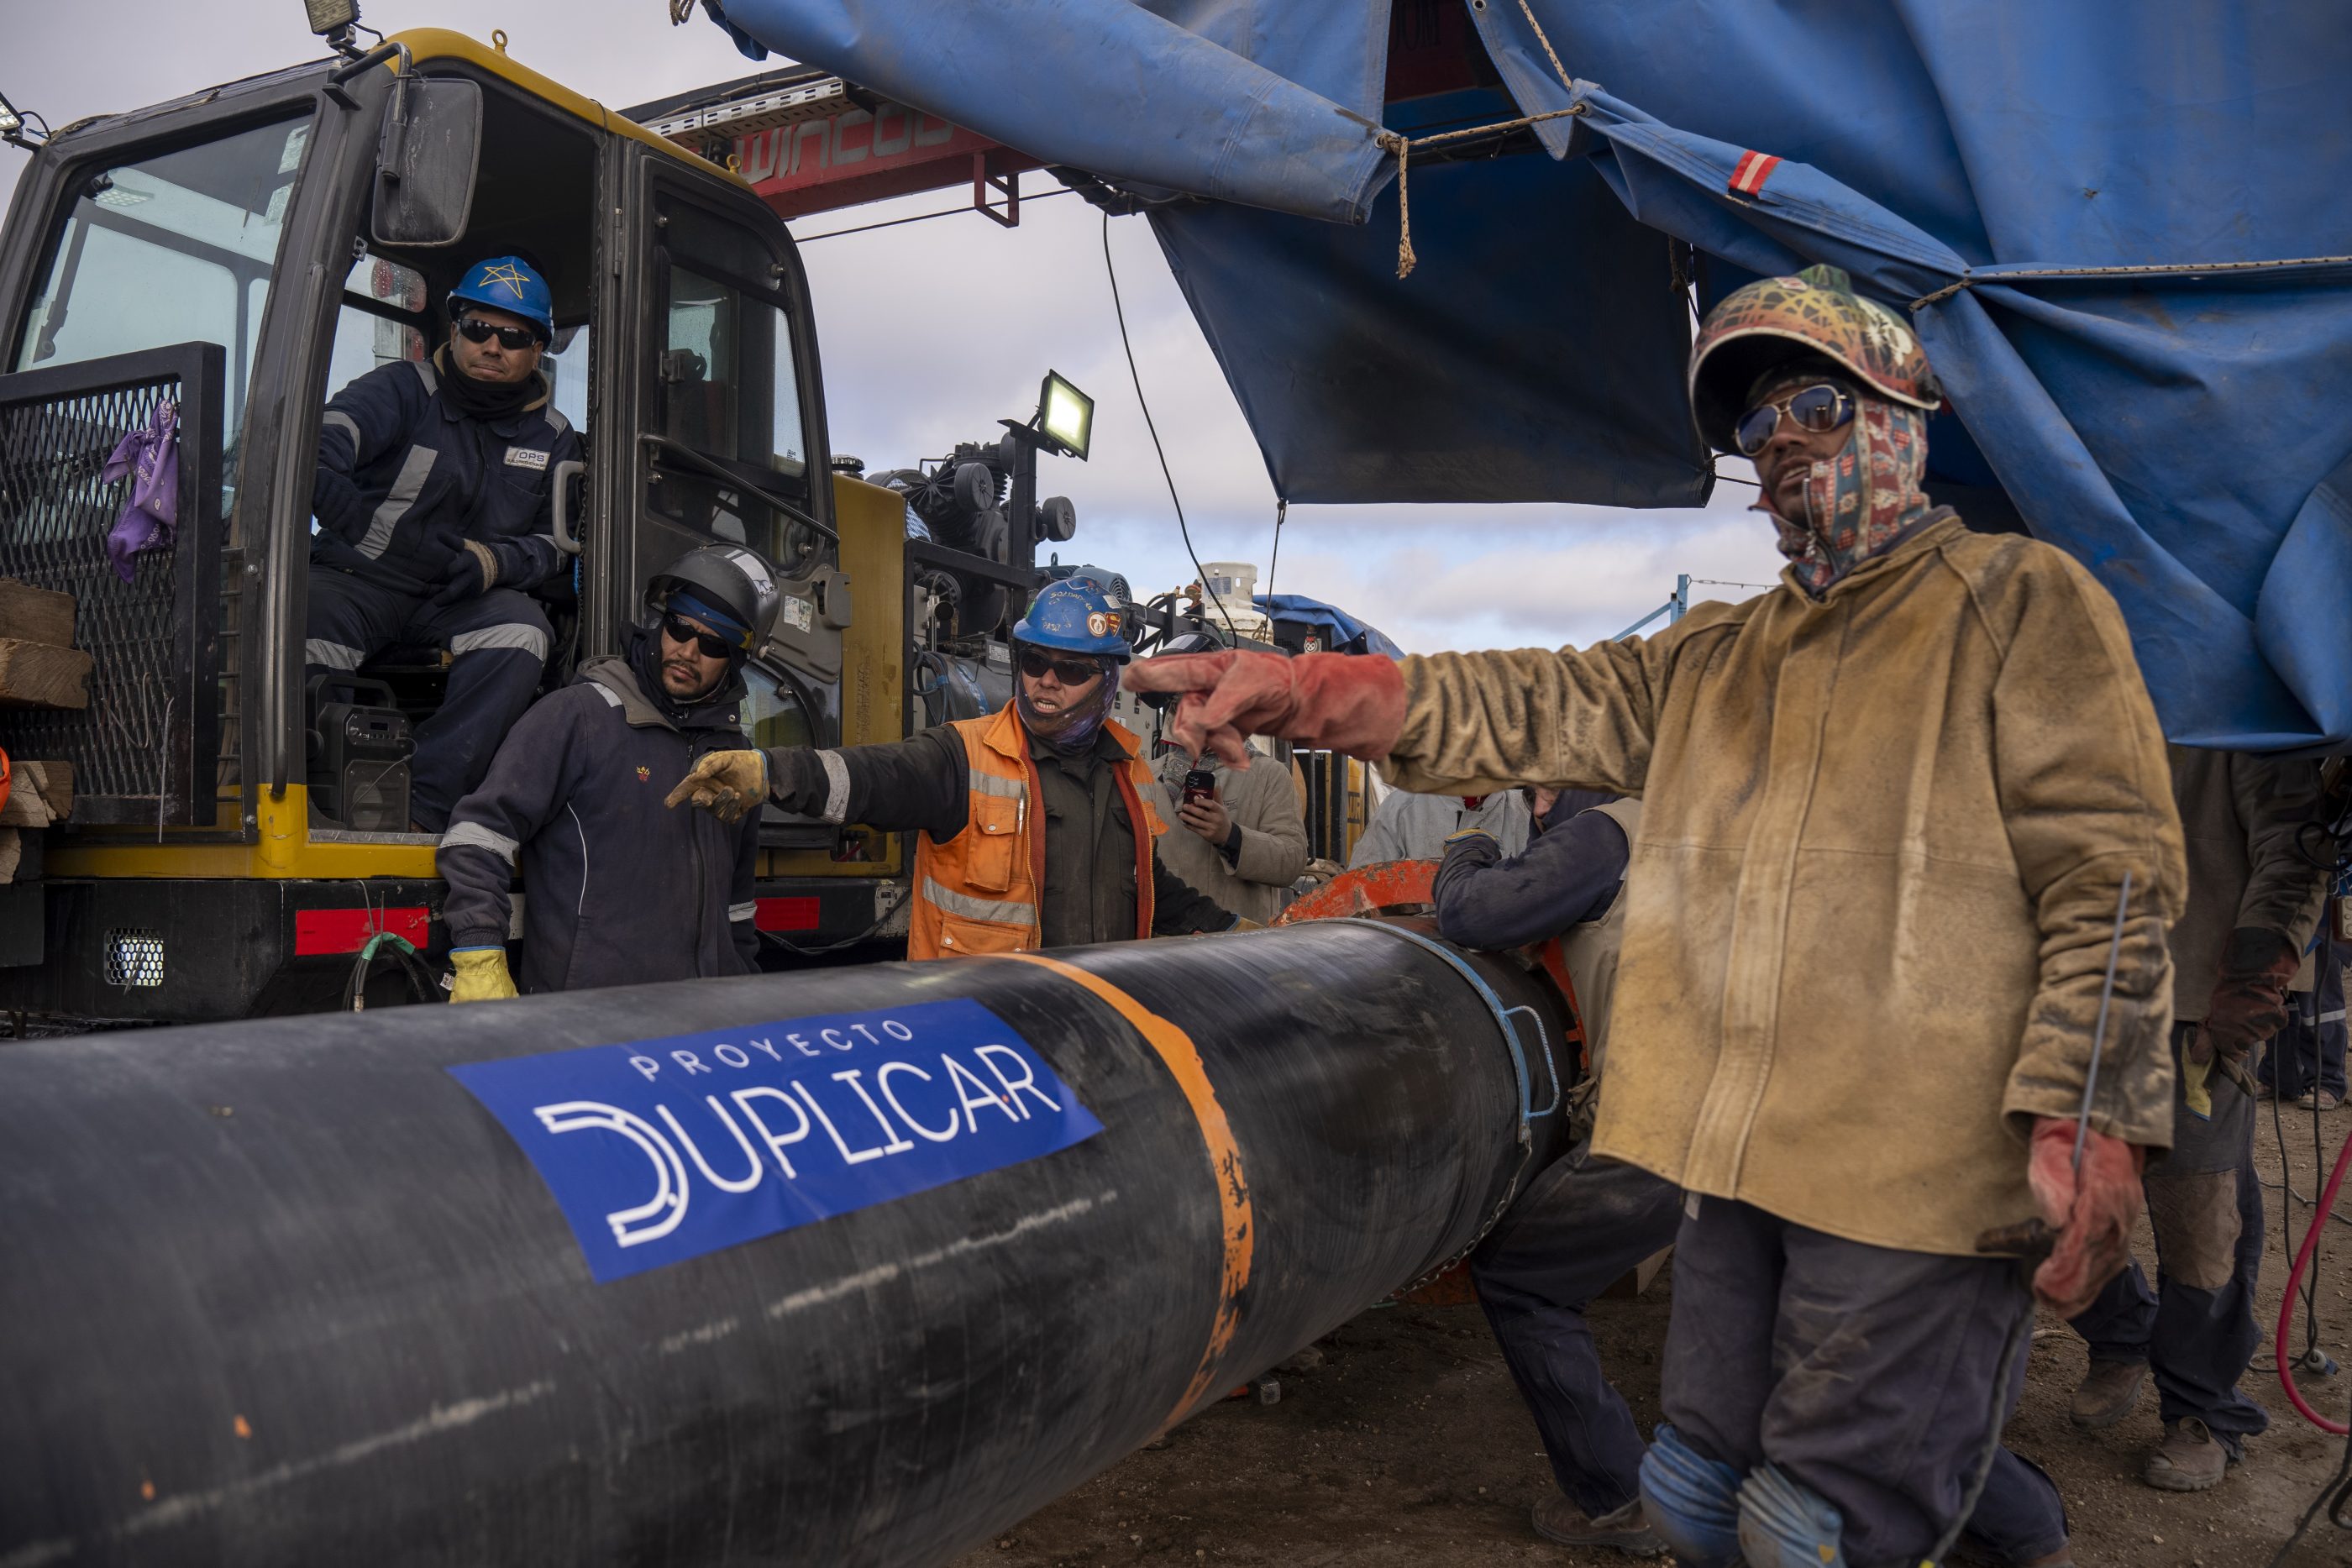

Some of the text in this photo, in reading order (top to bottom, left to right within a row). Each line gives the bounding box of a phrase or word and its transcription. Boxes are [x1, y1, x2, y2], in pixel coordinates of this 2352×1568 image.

[518, 452, 545, 462] OPS
[629, 1020, 913, 1083] PROYECTO
[533, 1044, 1062, 1249] DUPLICAR
